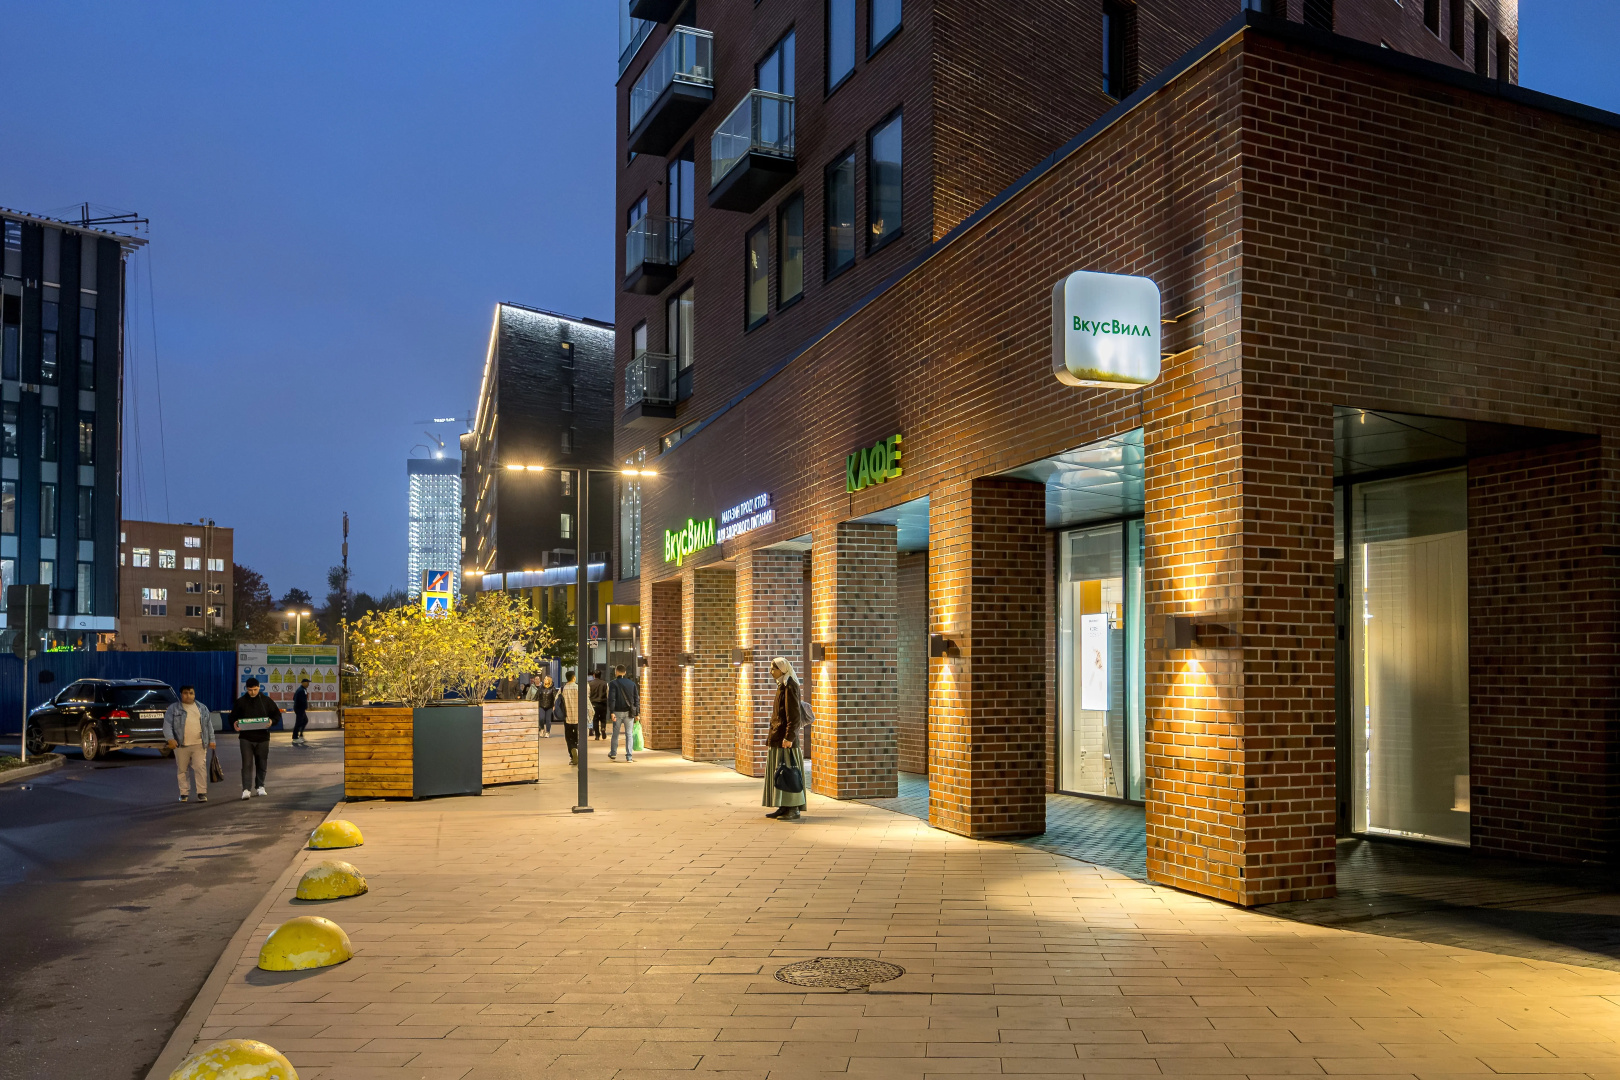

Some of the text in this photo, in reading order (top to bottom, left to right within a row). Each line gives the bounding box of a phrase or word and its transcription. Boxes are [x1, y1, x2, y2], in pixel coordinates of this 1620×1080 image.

[1073, 316, 1151, 336] ВкусВилл
[846, 434, 902, 493] КАФЕ
[751, 510, 771, 529] ПИТАНИЯ
[665, 517, 715, 566] ВкусВилл
